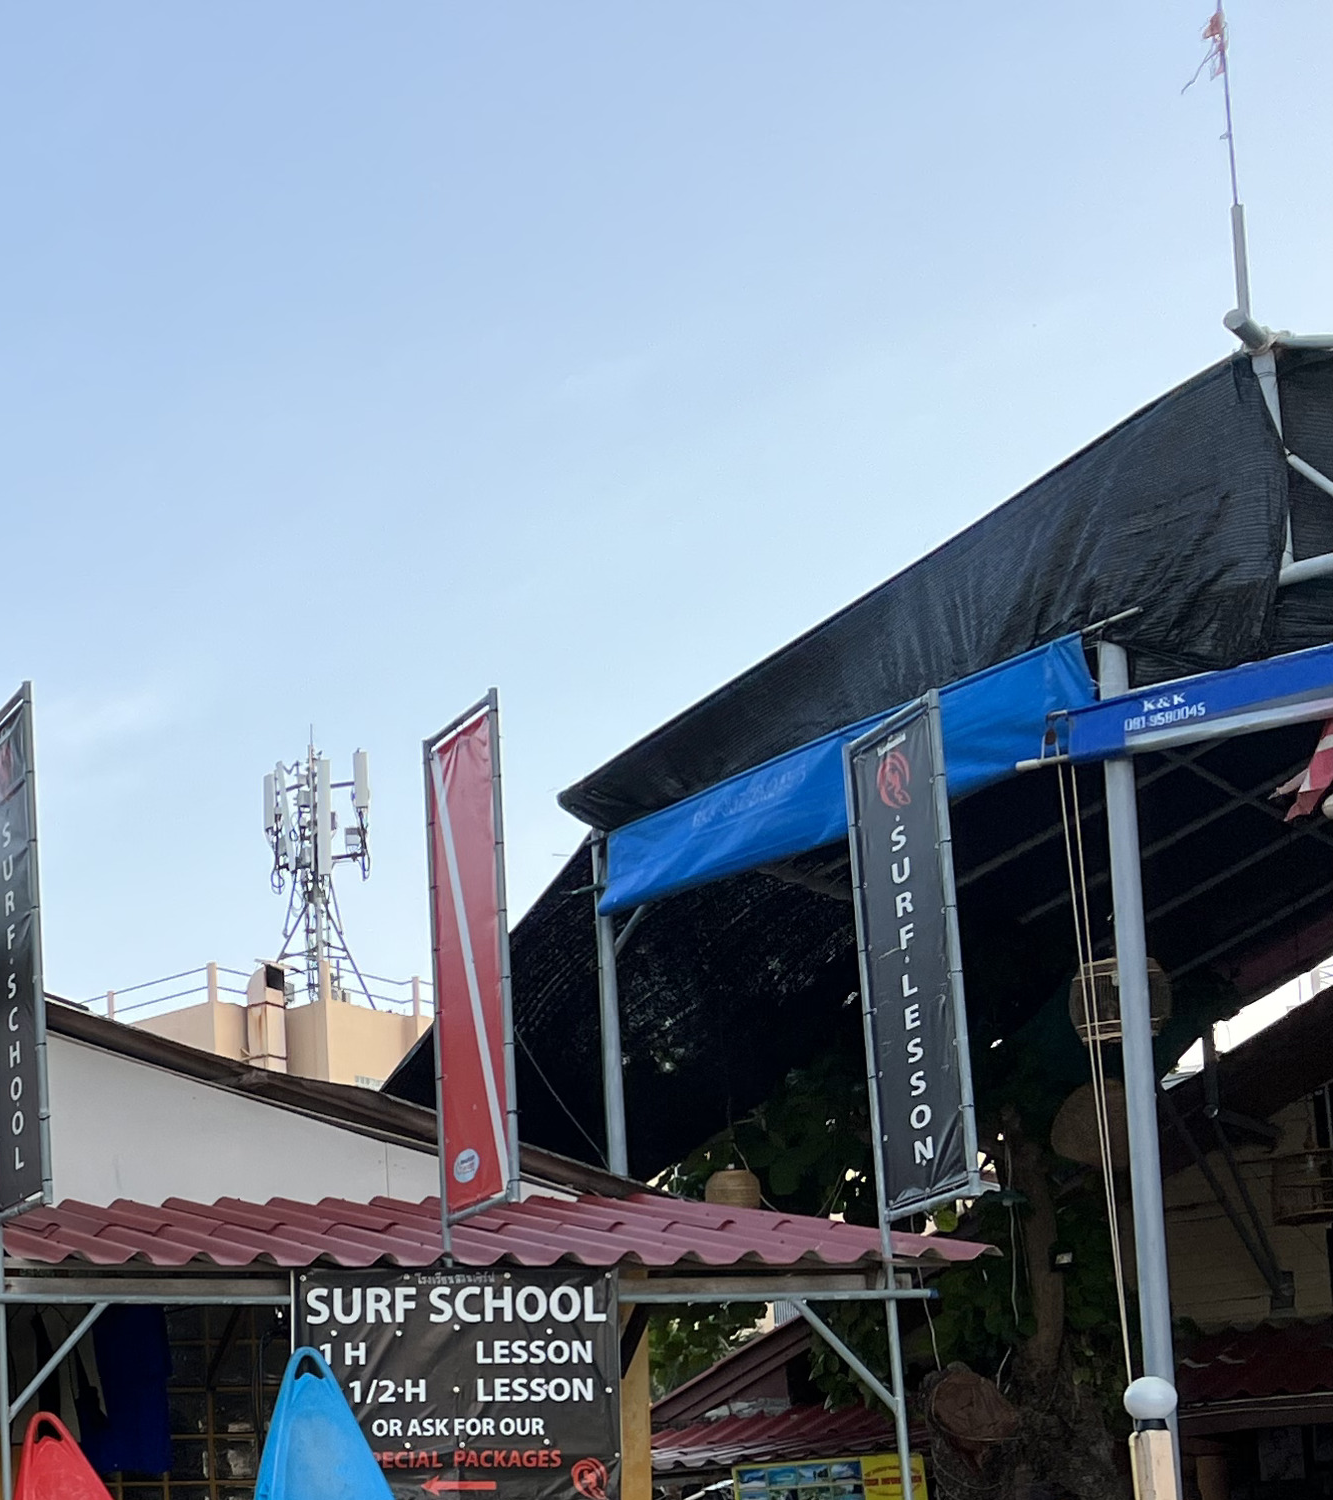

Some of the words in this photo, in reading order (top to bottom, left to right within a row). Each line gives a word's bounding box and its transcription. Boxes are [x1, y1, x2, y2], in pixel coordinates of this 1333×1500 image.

[2, 821, 15, 950] SURF
[888, 824, 914, 950] SURF
[901, 974, 934, 1164] LESSON
[7, 973, 25, 1170] SCHOOL
[306, 1286, 417, 1325] SURF
[429, 1285, 607, 1323] SCHOOL
[319, 1343, 332, 1366] 1
[344, 1342, 367, 1366] H
[476, 1340, 594, 1365] LESSON
[405, 1378, 427, 1403] H
[476, 1377, 594, 1403] LESSON
[371, 1419, 403, 1437] OR
[406, 1419, 450, 1437] ASK
[453, 1418, 496, 1436] FOR
[499, 1417, 546, 1436] OUR
[453, 1449, 562, 1468] PACKAGES
